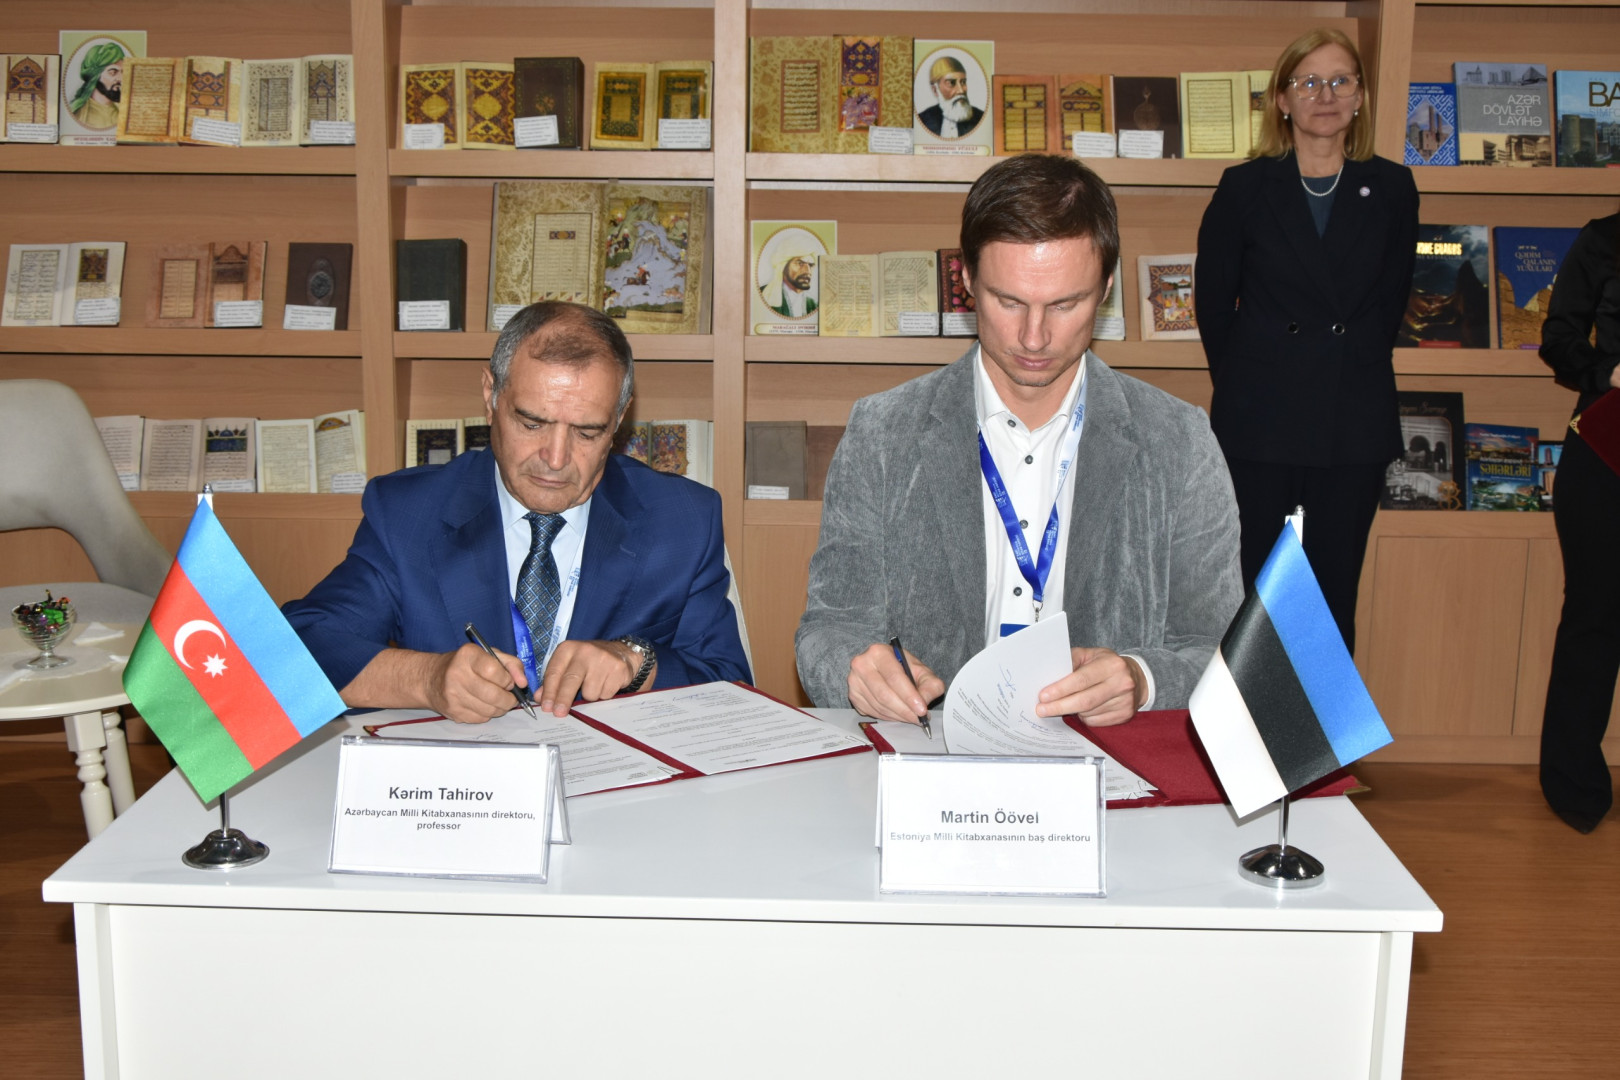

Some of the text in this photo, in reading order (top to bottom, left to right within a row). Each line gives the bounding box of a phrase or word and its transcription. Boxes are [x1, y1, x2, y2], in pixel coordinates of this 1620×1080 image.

[1507, 94, 1541, 105] AZƏR
[1483, 102, 1532, 116] DÖVLƏT
[389, 786, 494, 801] Kərim Tahirov
[344, 807, 536, 821] Azərbaycan Milli Kitabxanasının direktoru,
[941, 808, 1039, 824] Martin Öövel
[416, 821, 462, 831] professor
[890, 832, 1091, 844] Estoniya Milli Kitabxanasının baş direktoru
